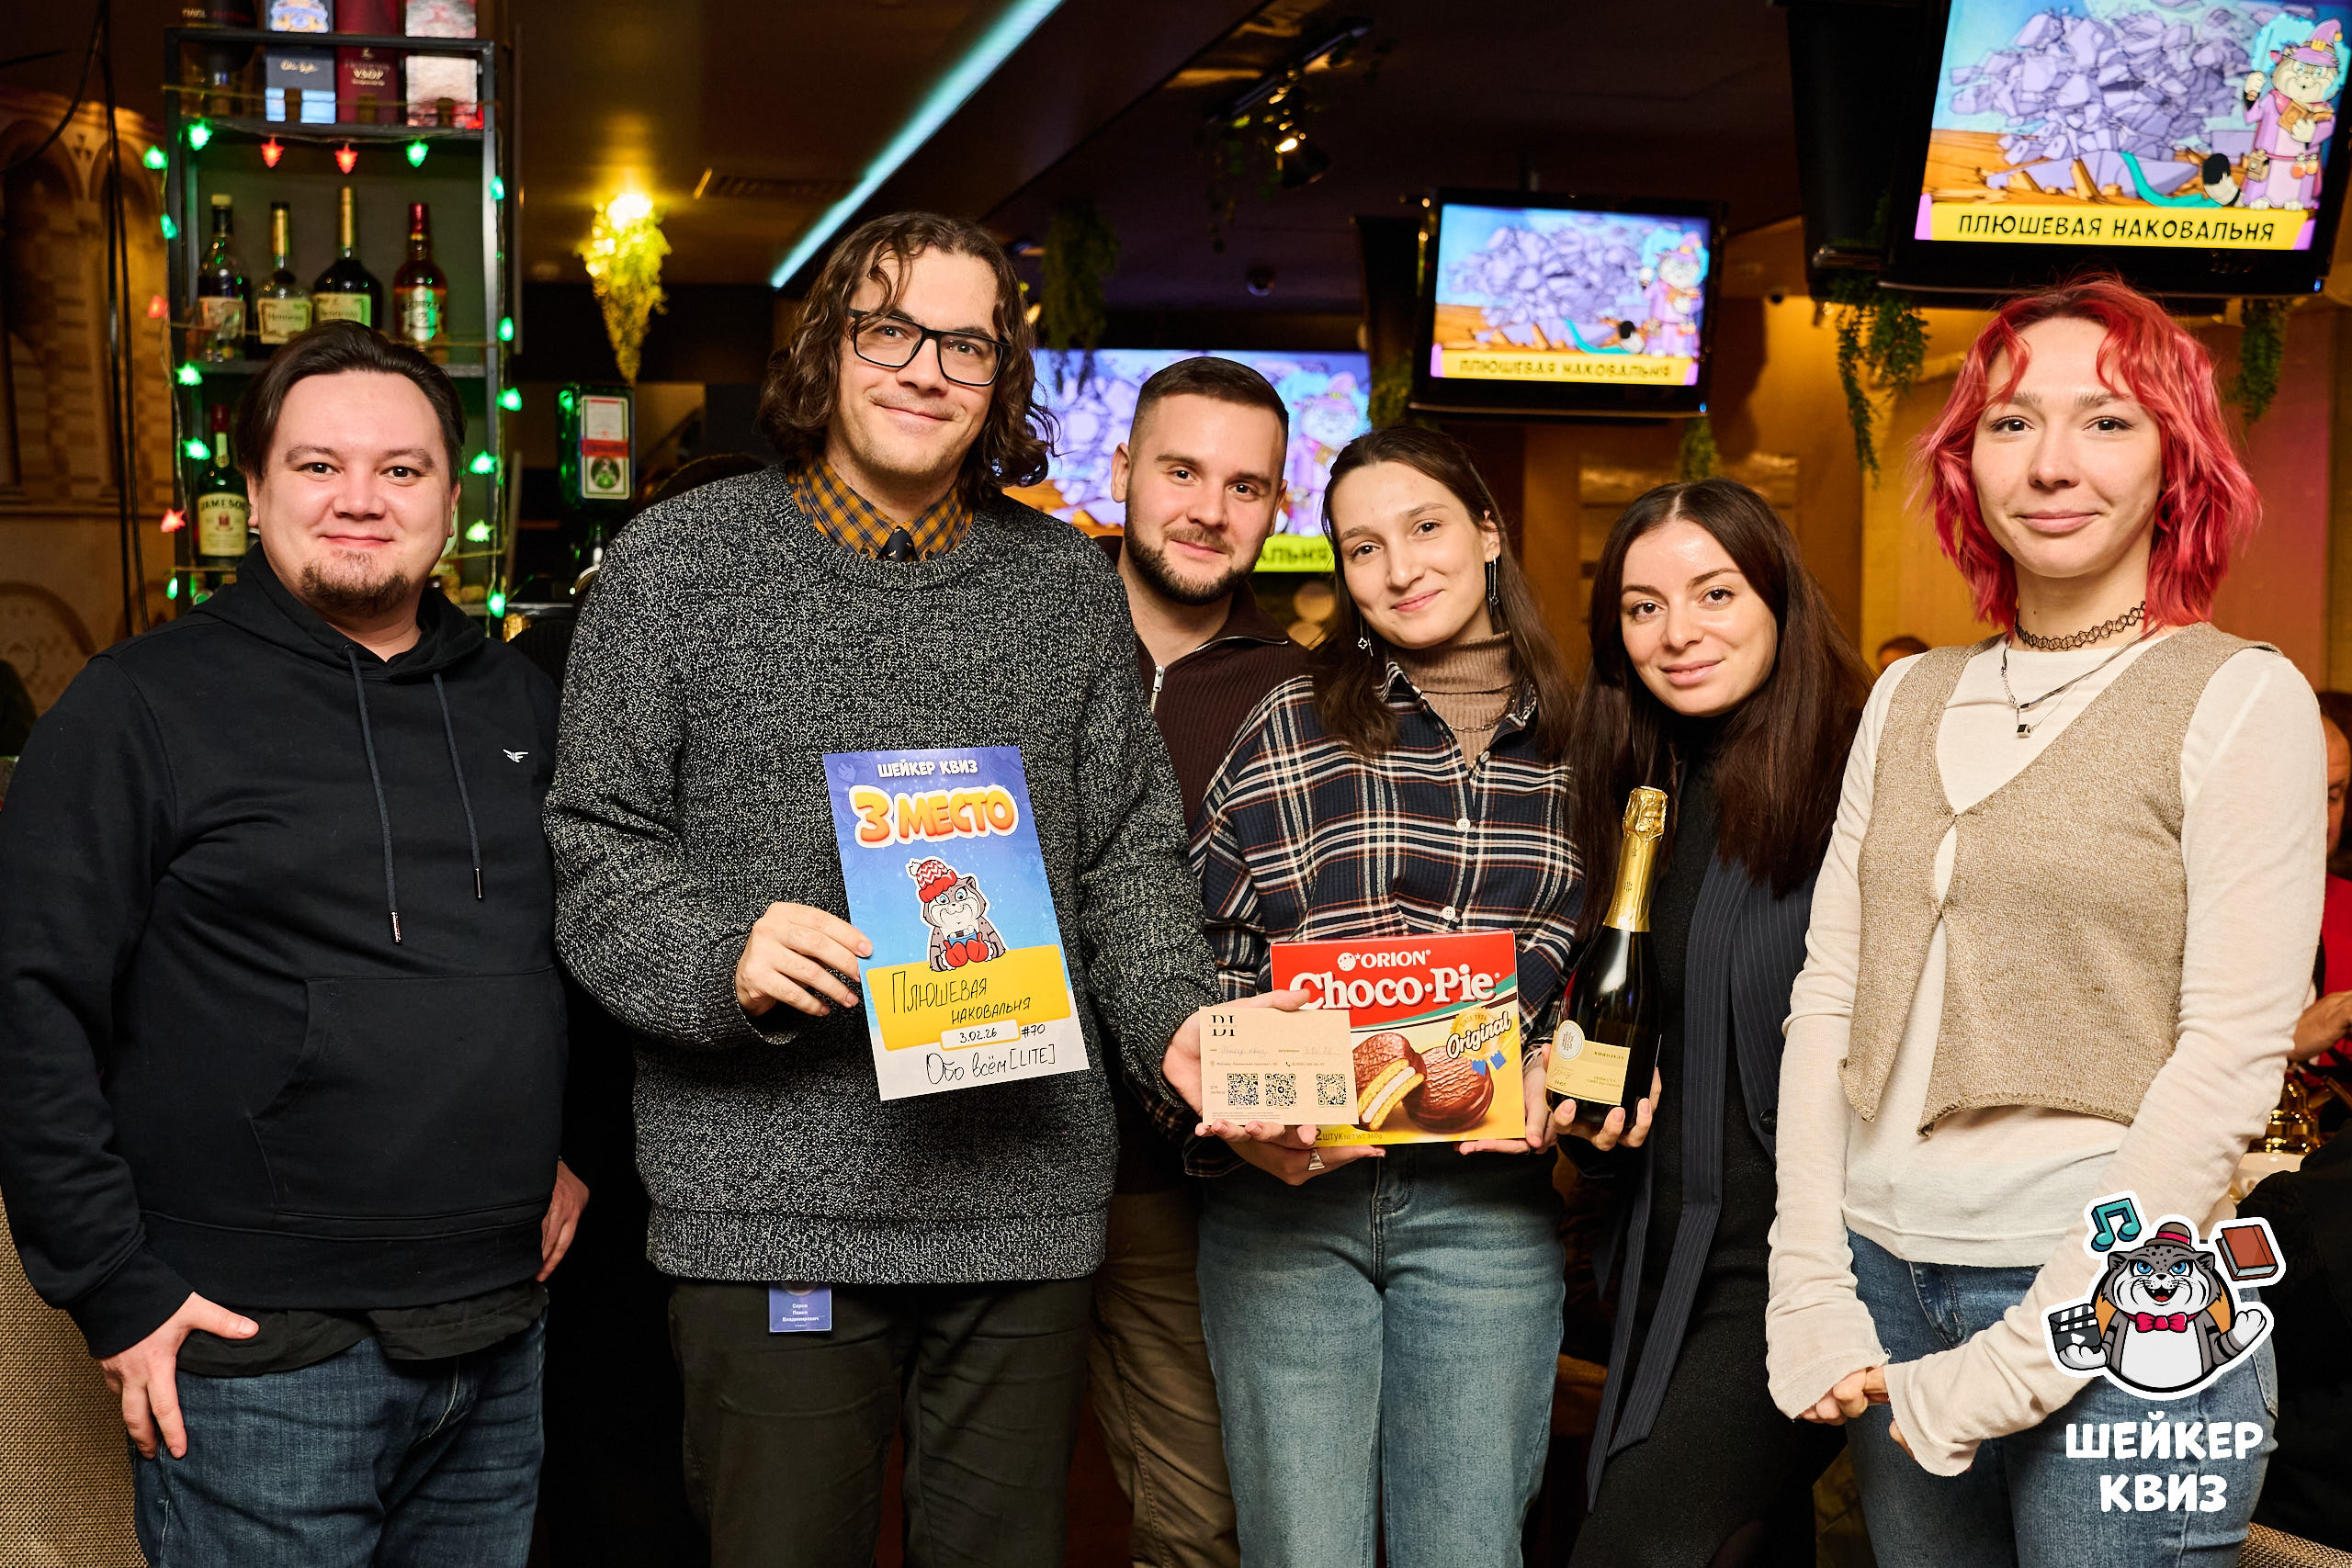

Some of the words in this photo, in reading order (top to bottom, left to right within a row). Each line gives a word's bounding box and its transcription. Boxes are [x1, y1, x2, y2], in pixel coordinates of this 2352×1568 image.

[1958, 214, 2102, 237] ПЛЮШЕВАЯ
[2113, 219, 2275, 241] НАКОВАЛЬНЯ
[1460, 359, 1555, 375] ПЛЮШЕВАЯ
[1563, 362, 1671, 378] НАКОВАЛЬНЯ
[877, 760, 935, 778] ШЕЙКЕР
[939, 759, 978, 775] КВИЗ
[854, 791, 890, 842] 3
[899, 791, 1016, 840] МЕСТО
[1361, 950, 1427, 969] ORION
[959, 1029, 998, 1043] 3.02.26
[1021, 1023, 1046, 1037] #70
[1446, 1010, 1512, 1060] Original
